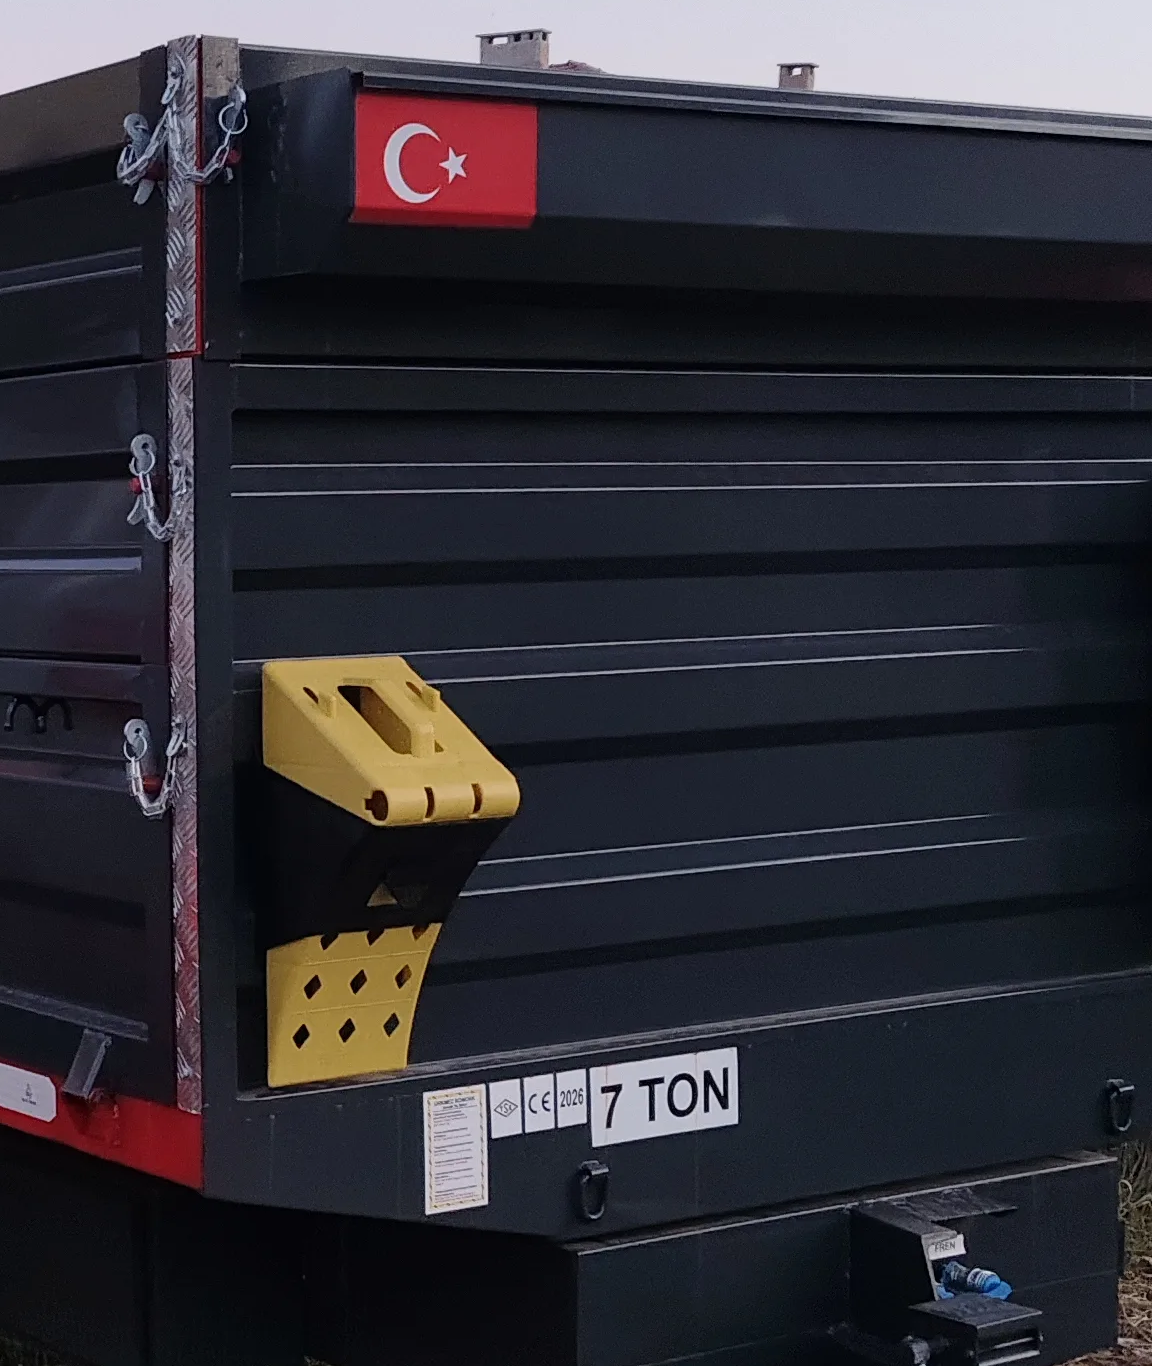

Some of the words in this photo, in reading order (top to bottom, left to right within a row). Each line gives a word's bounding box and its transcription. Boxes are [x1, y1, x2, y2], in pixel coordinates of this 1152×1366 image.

[560, 1088, 584, 1108] 2026
[601, 1084, 622, 1128] 7
[638, 1066, 729, 1122] TON
